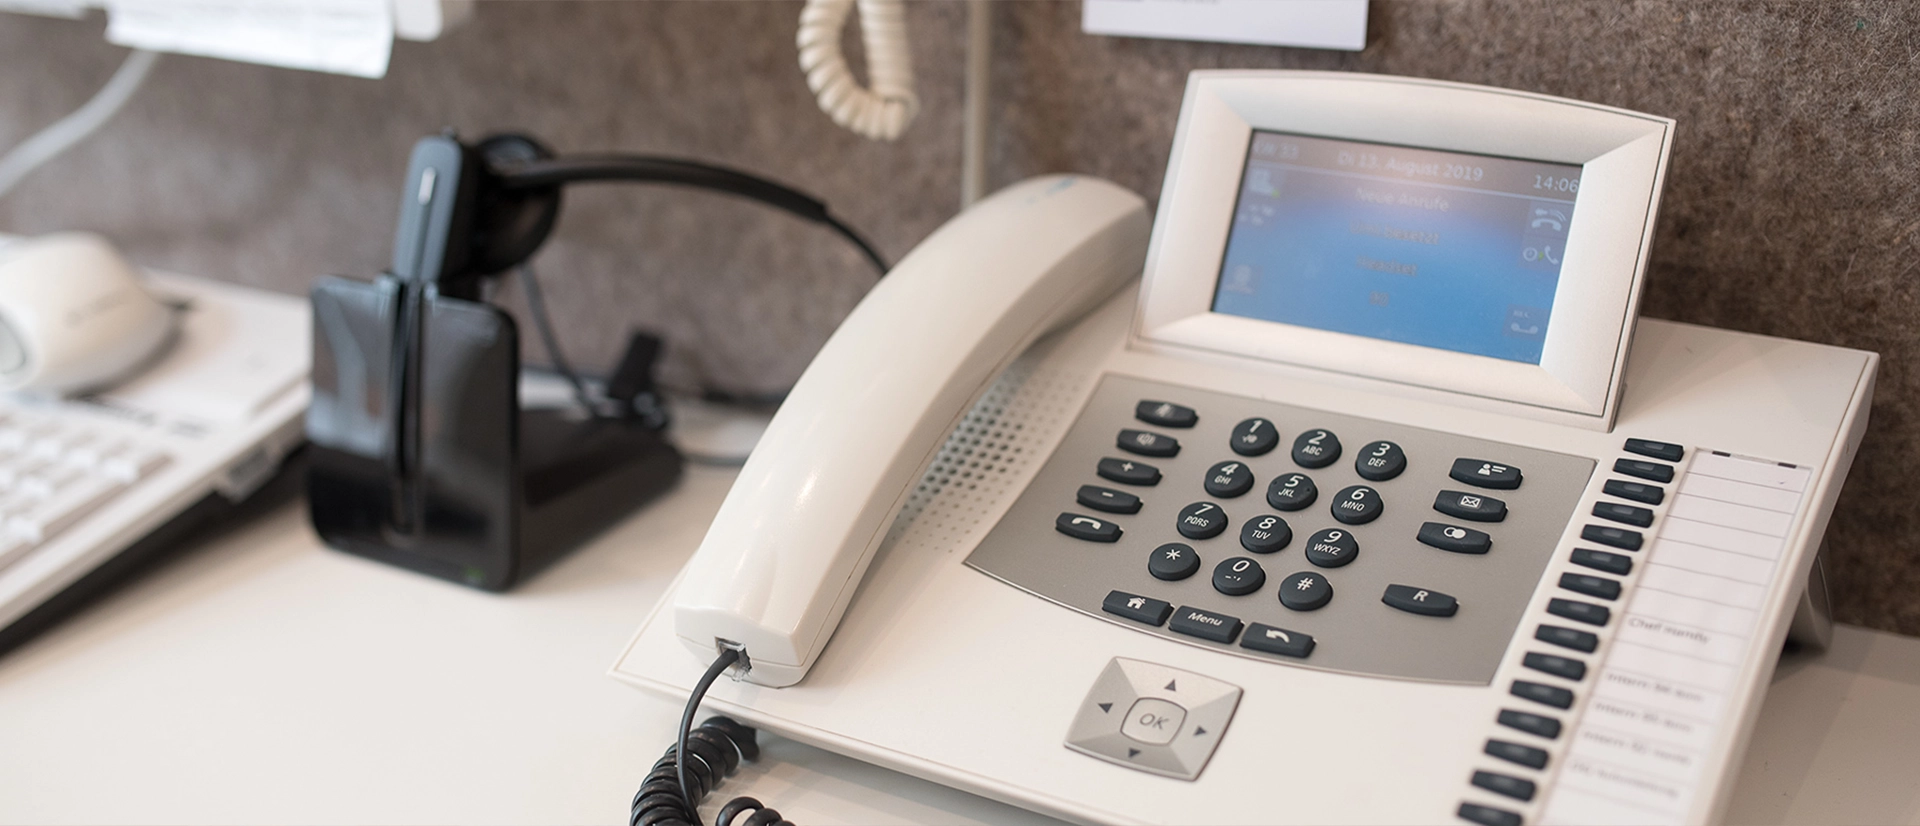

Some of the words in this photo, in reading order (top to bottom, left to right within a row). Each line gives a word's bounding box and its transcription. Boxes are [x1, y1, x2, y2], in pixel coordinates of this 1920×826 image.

[1337, 151, 1353, 165] Di
[1386, 157, 1440, 178] August
[1443, 163, 1484, 182] 2019
[1533, 174, 1579, 193] 14:06
[1355, 187, 1395, 206] Neue
[1397, 193, 1450, 212] Anrufe
[1249, 420, 1263, 433] 1
[1308, 431, 1327, 445] 2
[1302, 445, 1323, 456] ABC
[1372, 443, 1390, 456] 3
[1367, 457, 1387, 467] DEF
[1221, 463, 1240, 476] 4
[1214, 475, 1231, 485] GHI
[1284, 475, 1304, 488] 5
[1277, 488, 1295, 498] JKL
[1350, 488, 1369, 501] 6
[1194, 503, 1214, 515] 7
[1340, 500, 1365, 512] MNO
[1184, 515, 1210, 528] PQRS
[1258, 517, 1277, 530] 8
[1251, 529, 1271, 540] TUV
[1323, 531, 1342, 543] 9
[1313, 543, 1341, 556] WXYZ
[1232, 560, 1250, 572] 0
[1413, 590, 1429, 602] R
[1187, 612, 1223, 627] Menu
[1139, 713, 1170, 730] OK
